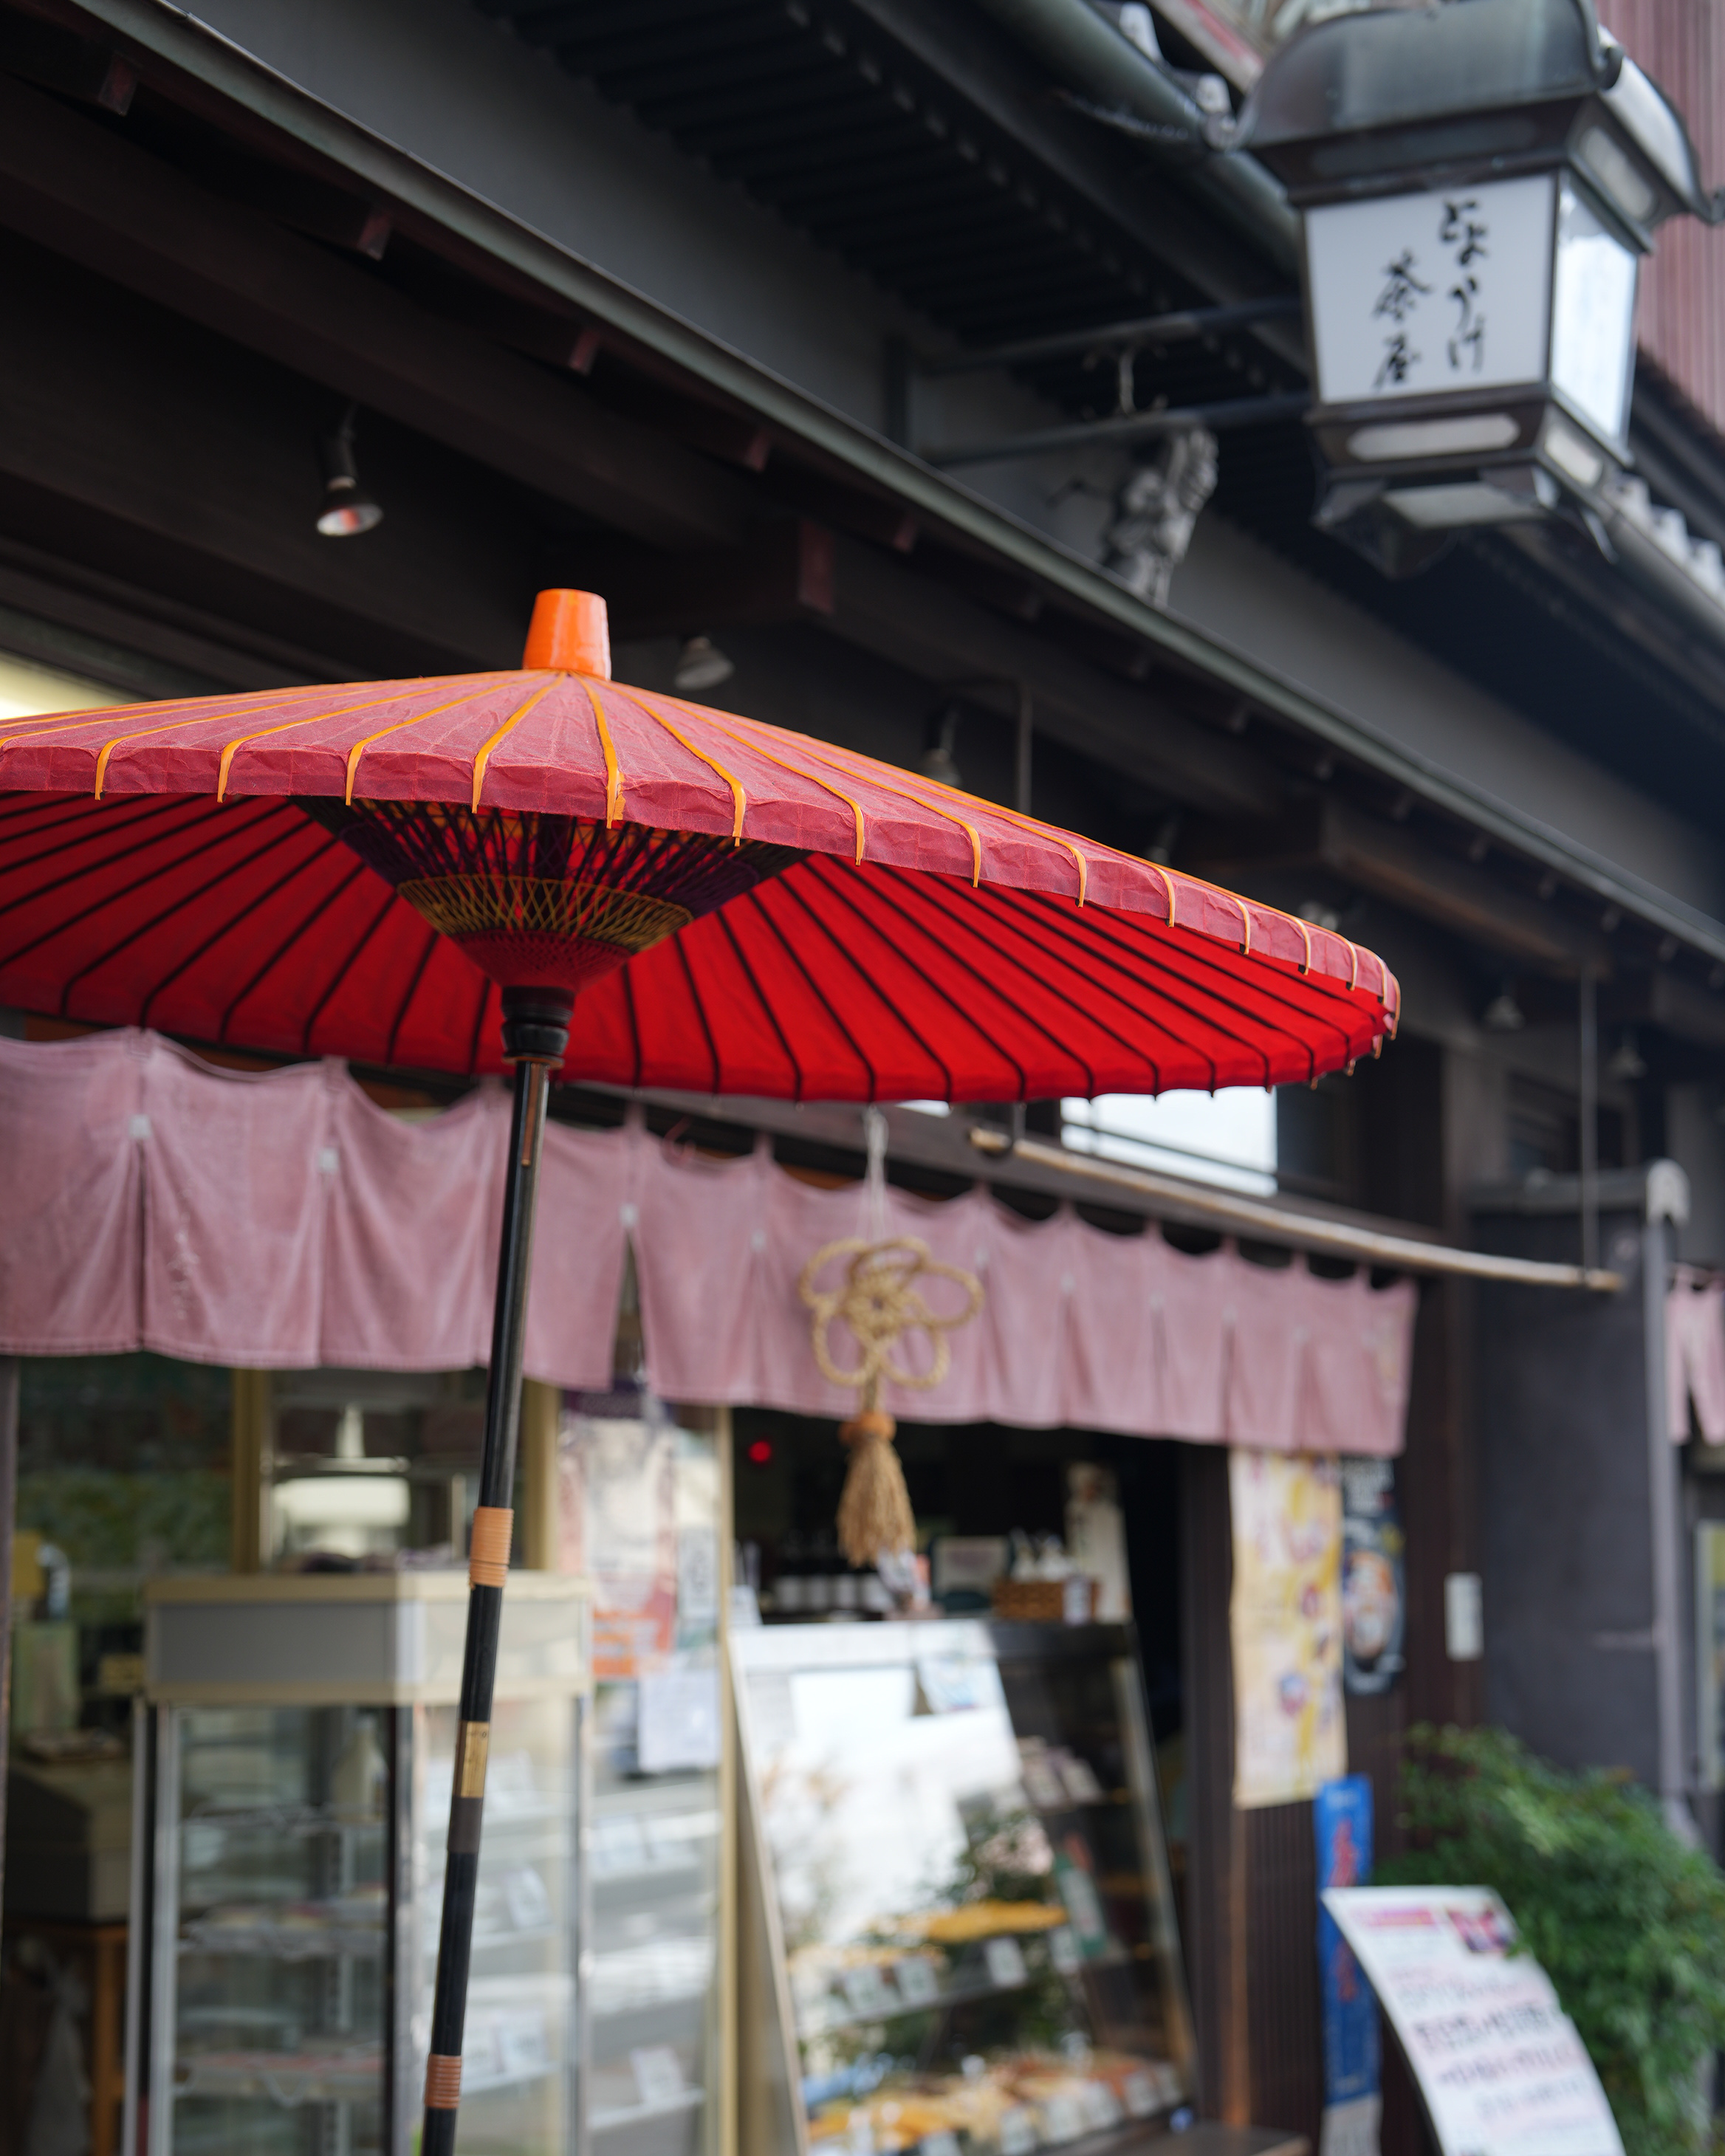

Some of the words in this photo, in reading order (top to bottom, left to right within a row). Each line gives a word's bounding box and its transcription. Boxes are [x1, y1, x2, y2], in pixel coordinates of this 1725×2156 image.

[1372, 248, 1433, 391] 茶屋
[1439, 199, 1487, 372] とようけ
